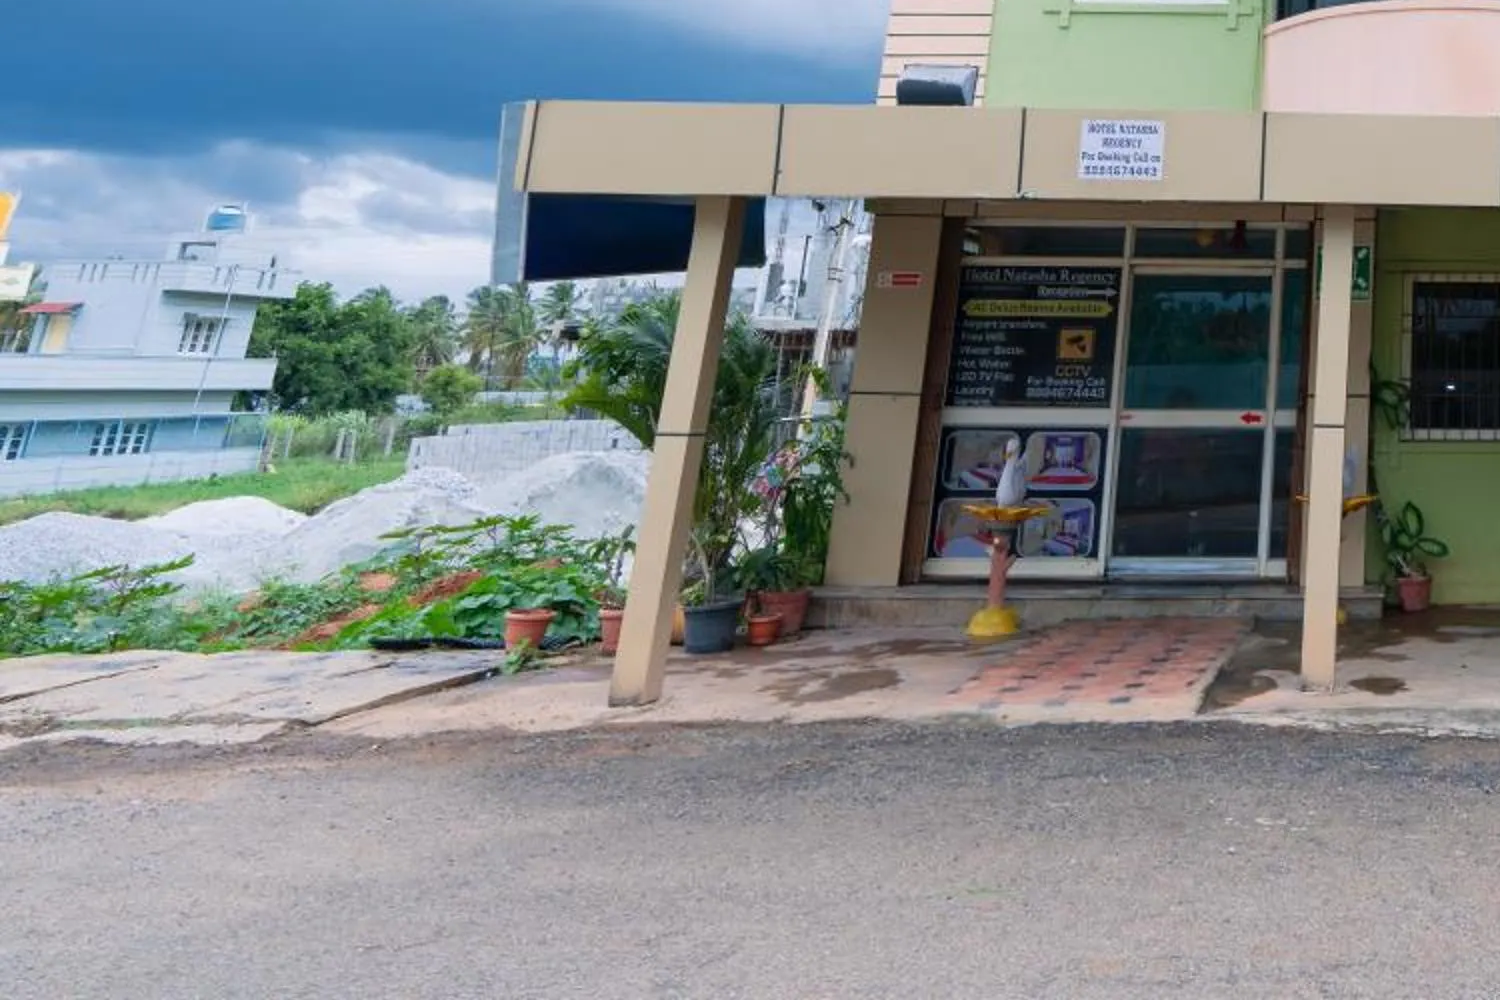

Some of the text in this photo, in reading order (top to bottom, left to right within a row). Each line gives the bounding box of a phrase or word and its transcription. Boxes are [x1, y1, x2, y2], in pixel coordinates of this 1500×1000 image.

[1088, 123, 1116, 134] HOTEL
[965, 267, 1115, 285] Hotel Natasha Regency
[1056, 364, 1092, 377] CCTV
